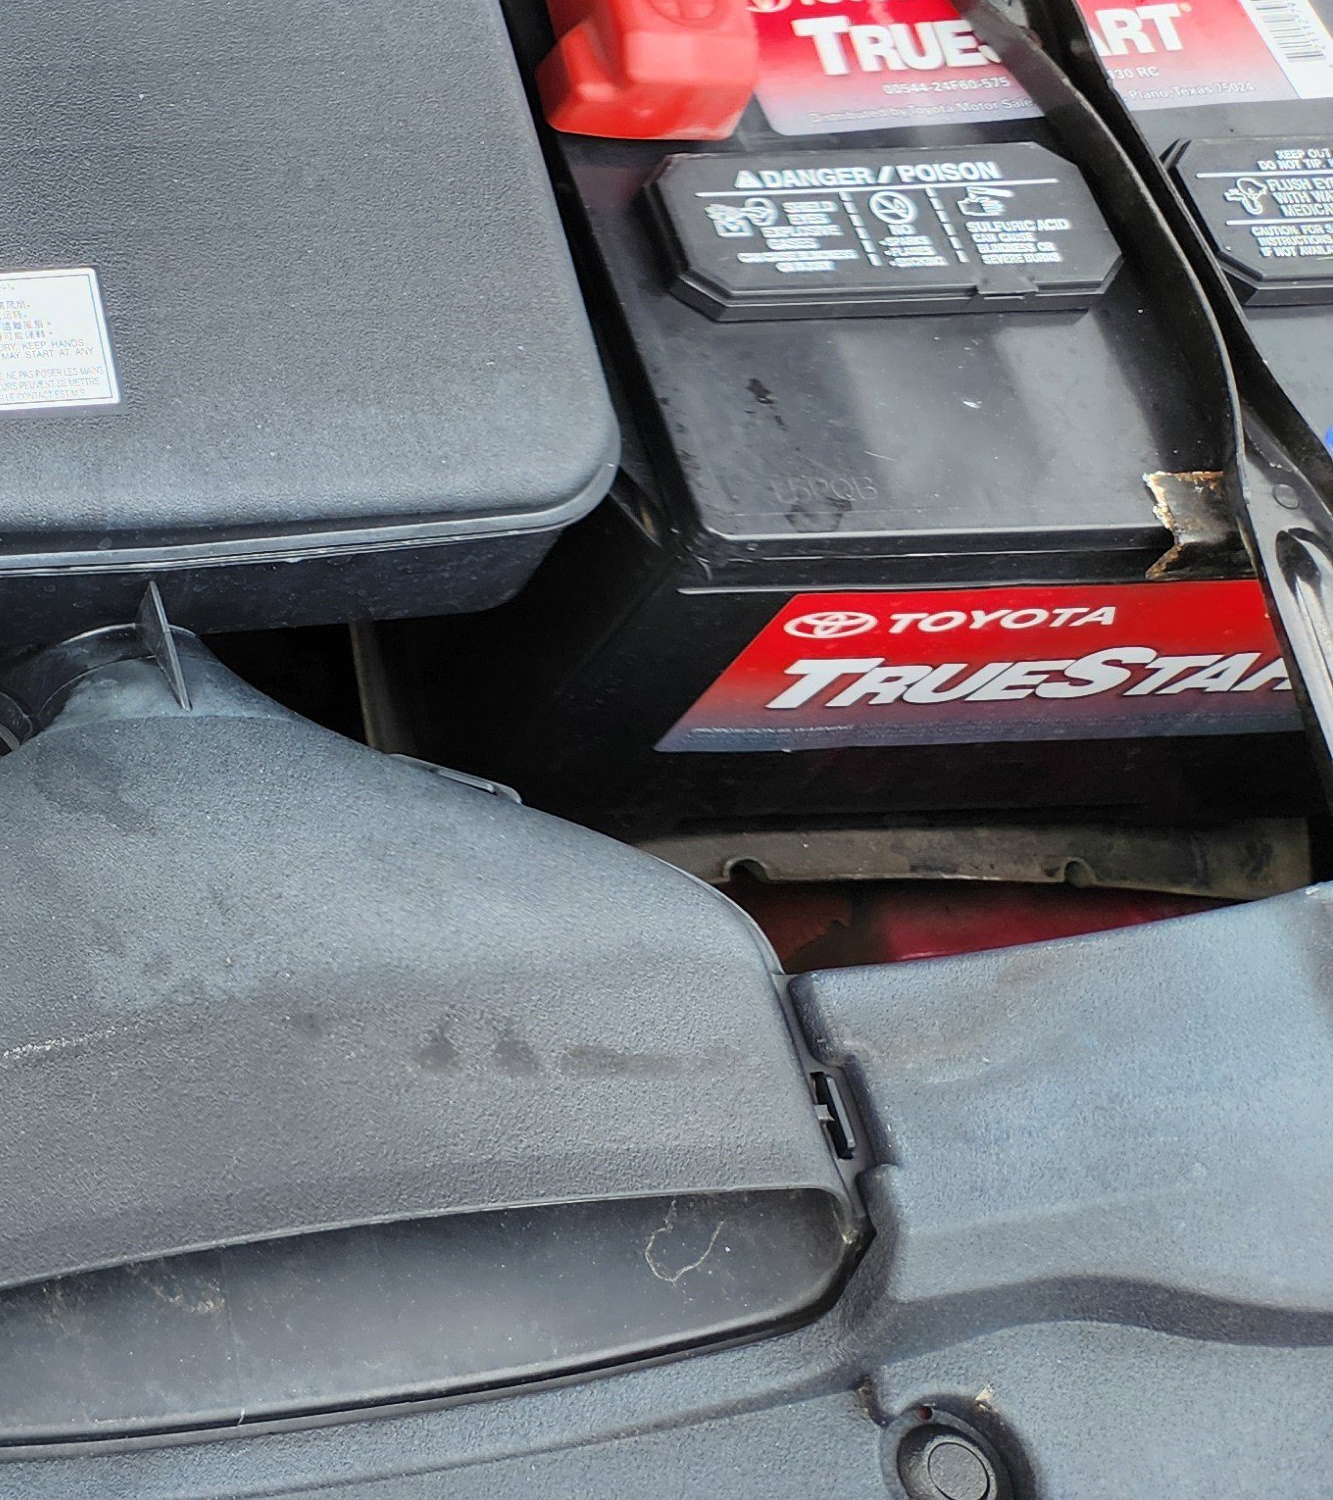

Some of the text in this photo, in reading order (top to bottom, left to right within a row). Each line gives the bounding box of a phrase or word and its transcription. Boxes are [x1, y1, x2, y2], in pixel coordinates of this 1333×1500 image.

[1136, 66, 1160, 78] RC
[1174, 85, 1214, 98] Texas
[1216, 82, 1255, 94] 75024
[908, 104, 954, 119] Toyota
[957, 101, 998, 114] Motor
[1001, 98, 1038, 111] Sale
[1275, 149, 1306, 160] KEEP
[1257, 160, 1277, 171] DO
[1277, 160, 1302, 170] NOT
[758, 167, 877, 188] DANGER
[896, 161, 1003, 183] POISON
[1265, 178, 1312, 192] FLUSH
[1272, 190, 1333, 205] WITH WA
[966, 218, 1072, 233] SULFURIC ACID
[1299, 225, 1324, 236] FOR
[1259, 247, 1272, 257] IF
[1273, 247, 1298, 257] NOT
[21, 340, 47, 350] KEEP
[51, 338, 84, 348] HANDS
[1, 352, 20, 360] MAY
[24, 349, 54, 359] START
[58, 348, 69, 356] AT
[74, 347, 94, 355] ANY
[18, 369, 34, 379] PAS
[35, 368, 62, 377] POSER
[63, 367, 78, 376] LES
[887, 606, 1116, 633] TOYOTA
[766, 647, 1294, 709] TRUESTA
